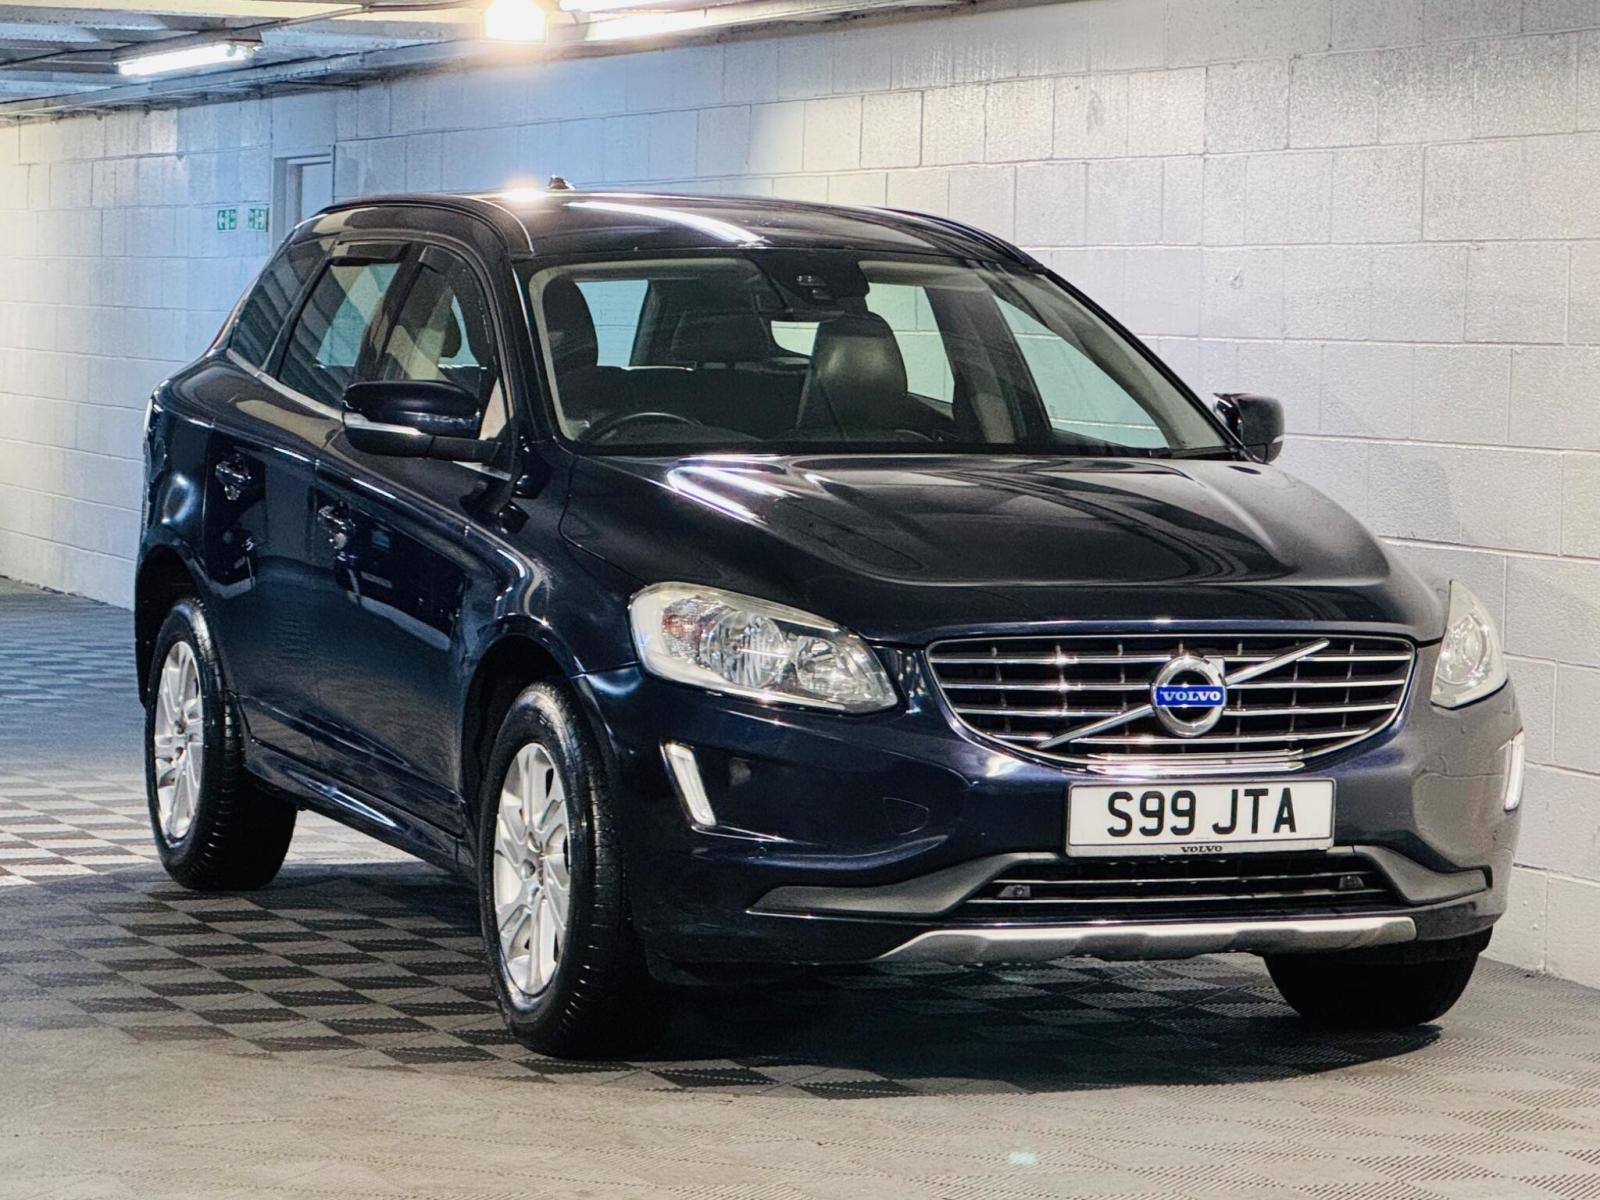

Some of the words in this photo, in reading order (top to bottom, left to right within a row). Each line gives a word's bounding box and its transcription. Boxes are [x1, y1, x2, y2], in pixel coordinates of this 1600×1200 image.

[1160, 691, 1221, 701] VOLVO
[1107, 790, 1196, 837] S99
[1212, 787, 1296, 834] JTA
[1180, 845, 1223, 853] VOLVO
